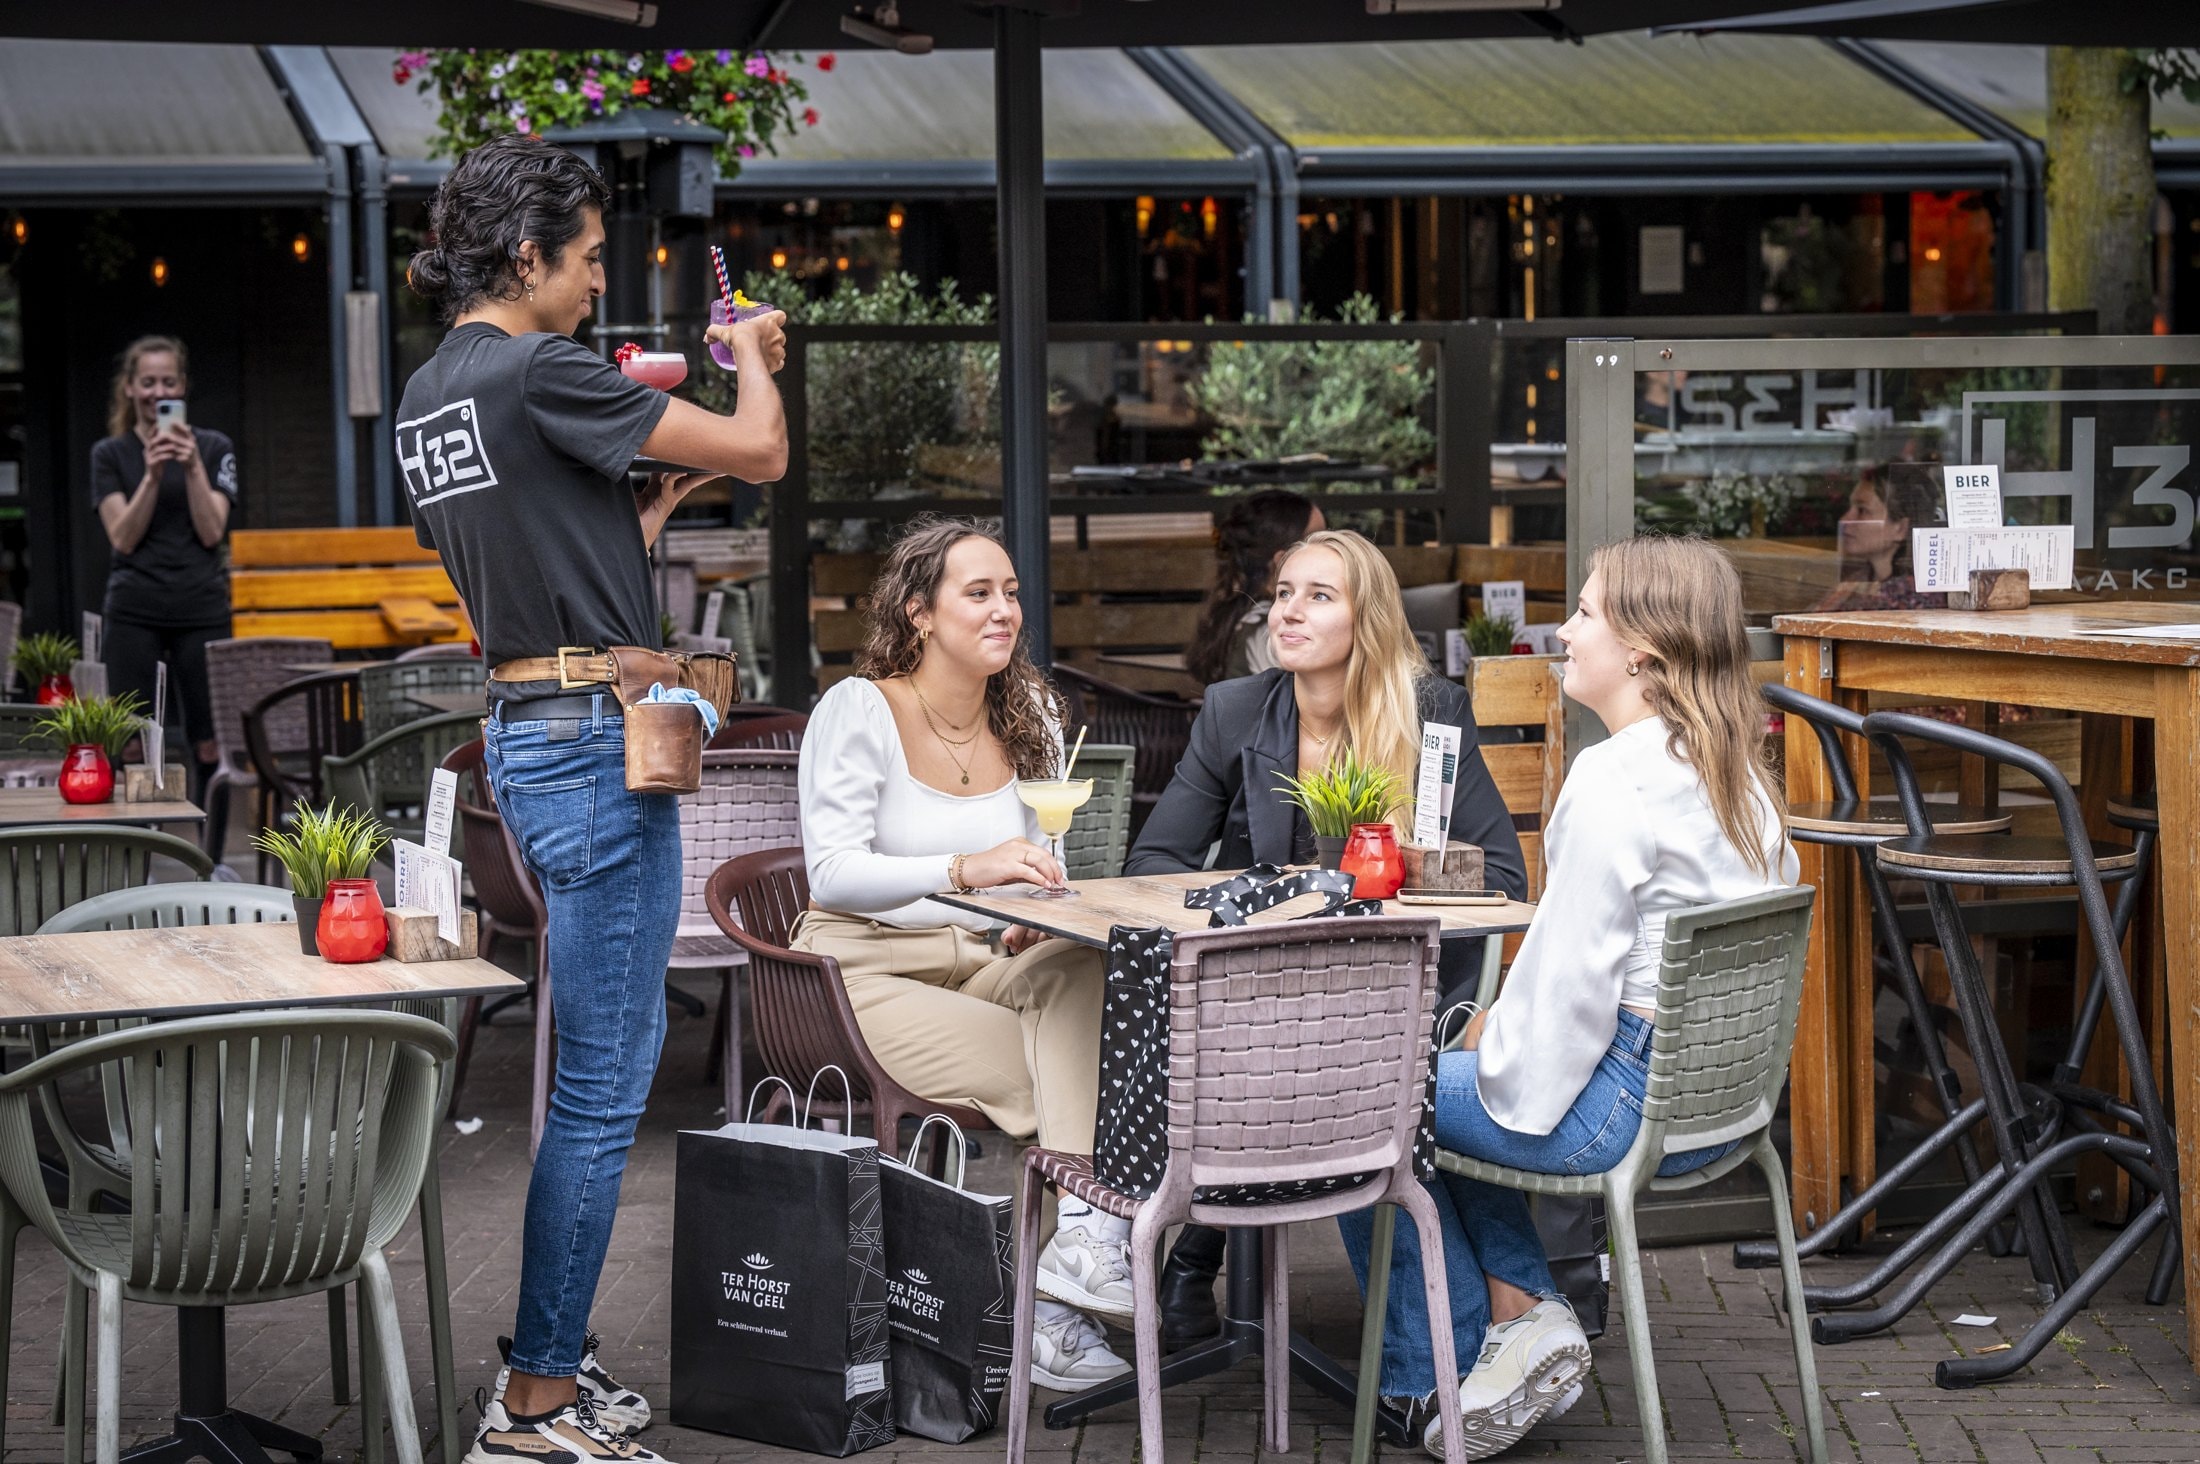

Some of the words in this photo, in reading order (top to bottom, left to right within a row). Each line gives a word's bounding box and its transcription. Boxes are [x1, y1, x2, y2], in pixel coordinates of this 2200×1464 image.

[1595, 355, 1604, 367] 9
[1609, 355, 1618, 366] 9
[396, 429, 483, 495] H32
[1955, 475, 1990, 488] BIER
[1927, 533, 1939, 587] BORREL
[1424, 734, 1440, 751] BIER
[721, 1271, 744, 1288] TER
[747, 1273, 791, 1295] HORST
[724, 1286, 751, 1303] VAN
[753, 1292, 785, 1310] GEEL
[907, 1284, 945, 1310] HORST
[912, 1302, 940, 1322] GEEL
[717, 1318, 729, 1327] Een
[729, 1321, 763, 1334] schitterend
